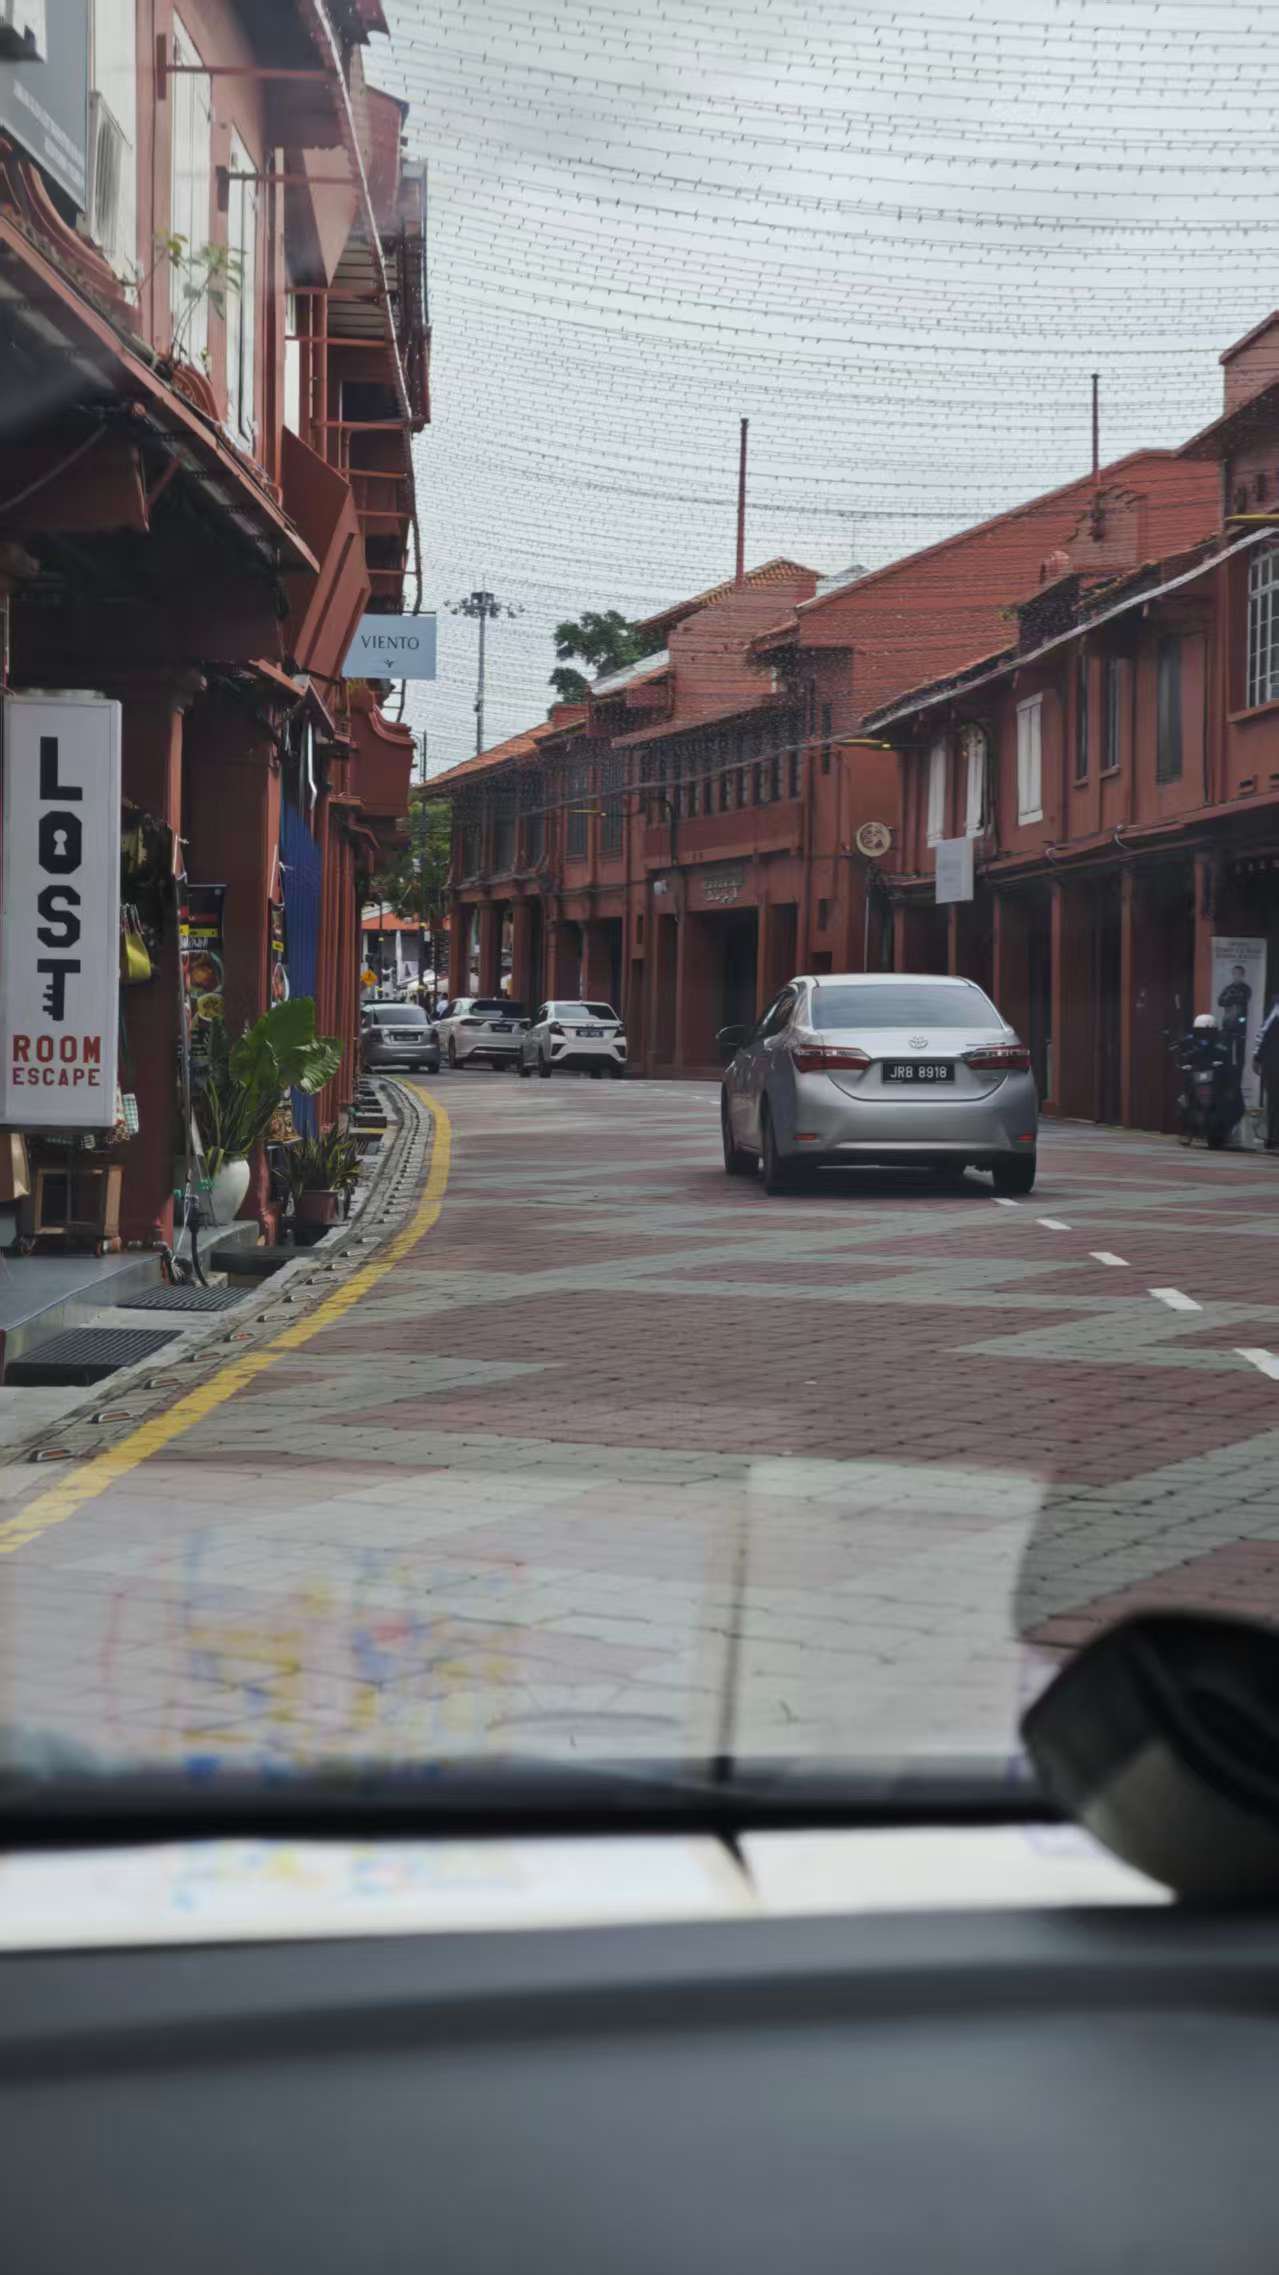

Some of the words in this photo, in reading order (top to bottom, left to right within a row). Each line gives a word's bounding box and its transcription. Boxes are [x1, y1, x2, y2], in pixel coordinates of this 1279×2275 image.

[361, 635, 420, 650] VIENTO
[37, 736, 83, 1021] LOST
[13, 1034, 101, 1064] ROOM
[12, 1067, 100, 1086] ESCAPE
[918, 1065, 948, 1079] 8918
